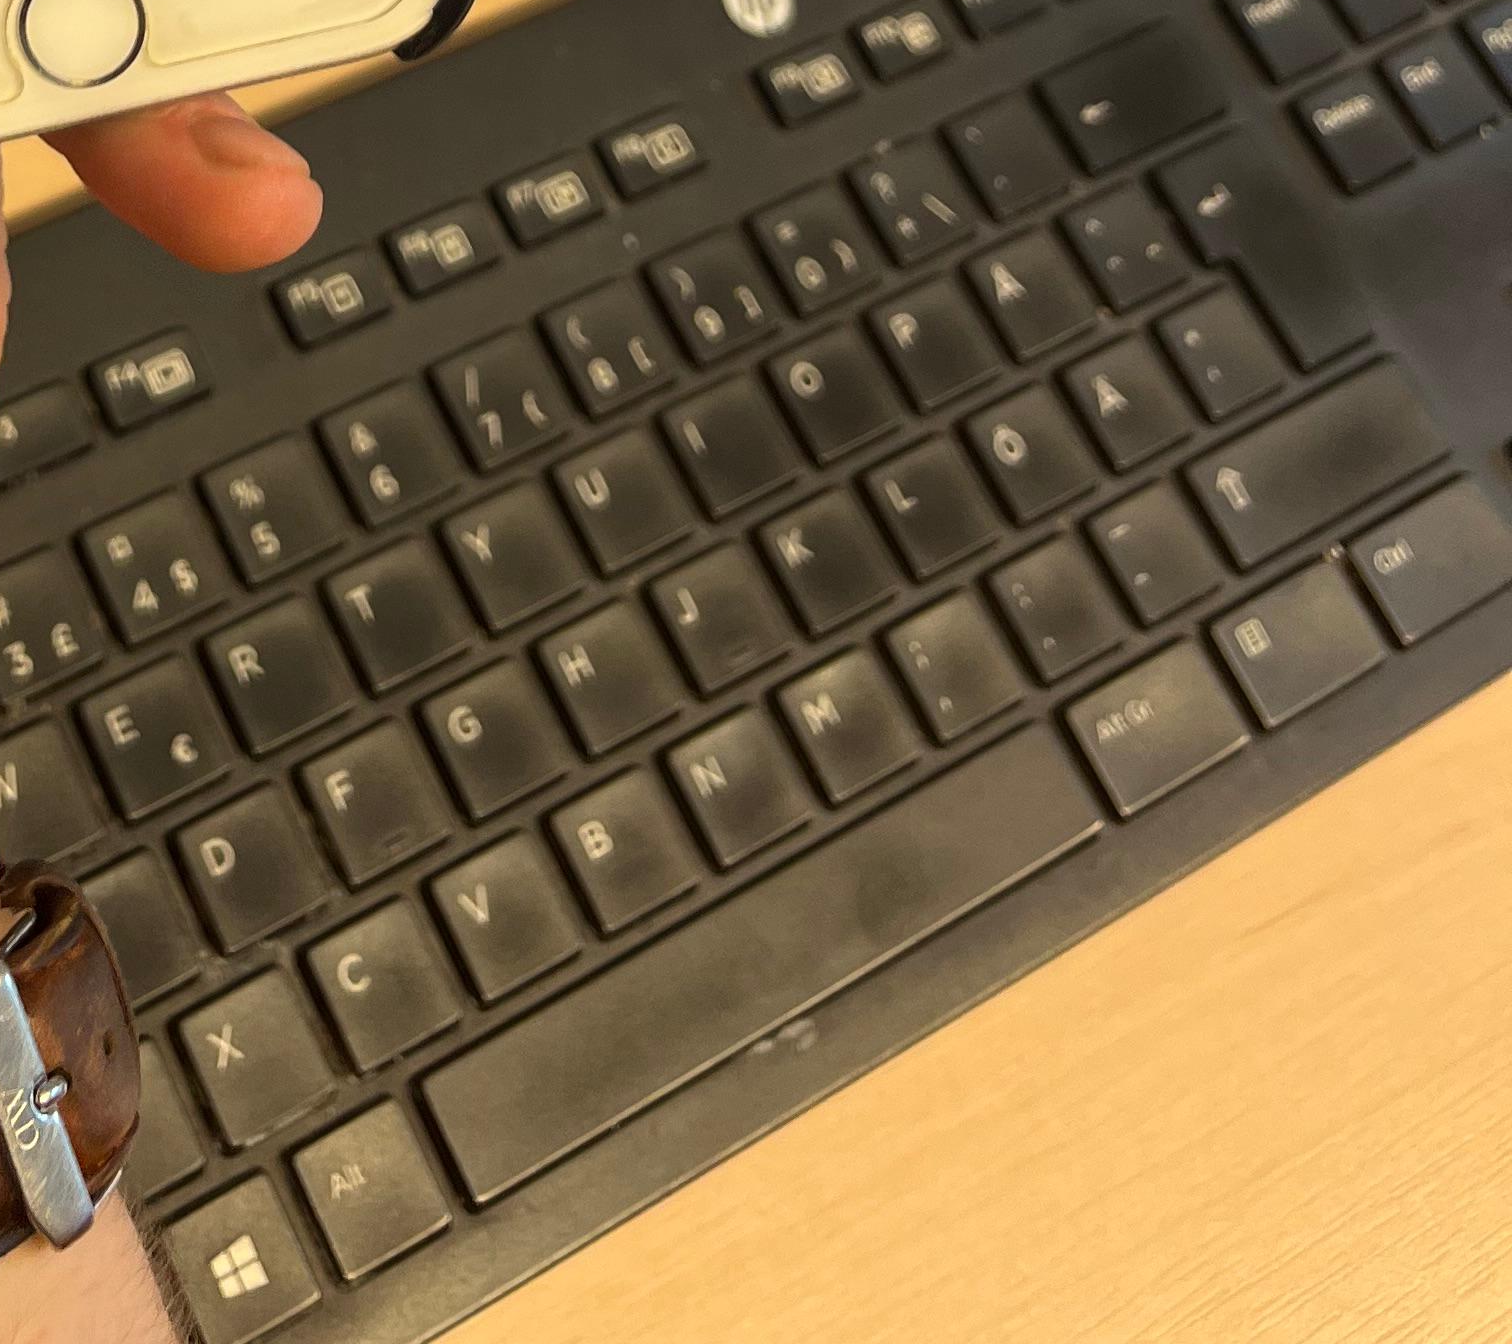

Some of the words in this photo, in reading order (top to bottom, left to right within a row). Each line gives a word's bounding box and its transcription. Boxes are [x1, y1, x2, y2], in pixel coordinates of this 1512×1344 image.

[888, 311, 920, 351] P
[789, 360, 827, 400] O
[574, 465, 611, 511] U
[884, 477, 921, 514] L
[249, 519, 282, 560] 5
[460, 522, 494, 563] Y
[775, 526, 816, 570] K
[344, 582, 376, 625] T
[675, 586, 701, 627] J
[1, 639, 36, 680] 3
[227, 642, 266, 687] R
[556, 642, 597, 688] H
[102, 703, 141, 746] E
[446, 704, 484, 745] G
[799, 690, 843, 737] M
[323, 767, 355, 812] F
[688, 753, 729, 800] N
[198, 836, 238, 878] D
[575, 818, 615, 861] B
[456, 882, 491, 925] V
[335, 952, 373, 994] C
[205, 1022, 246, 1073] X
